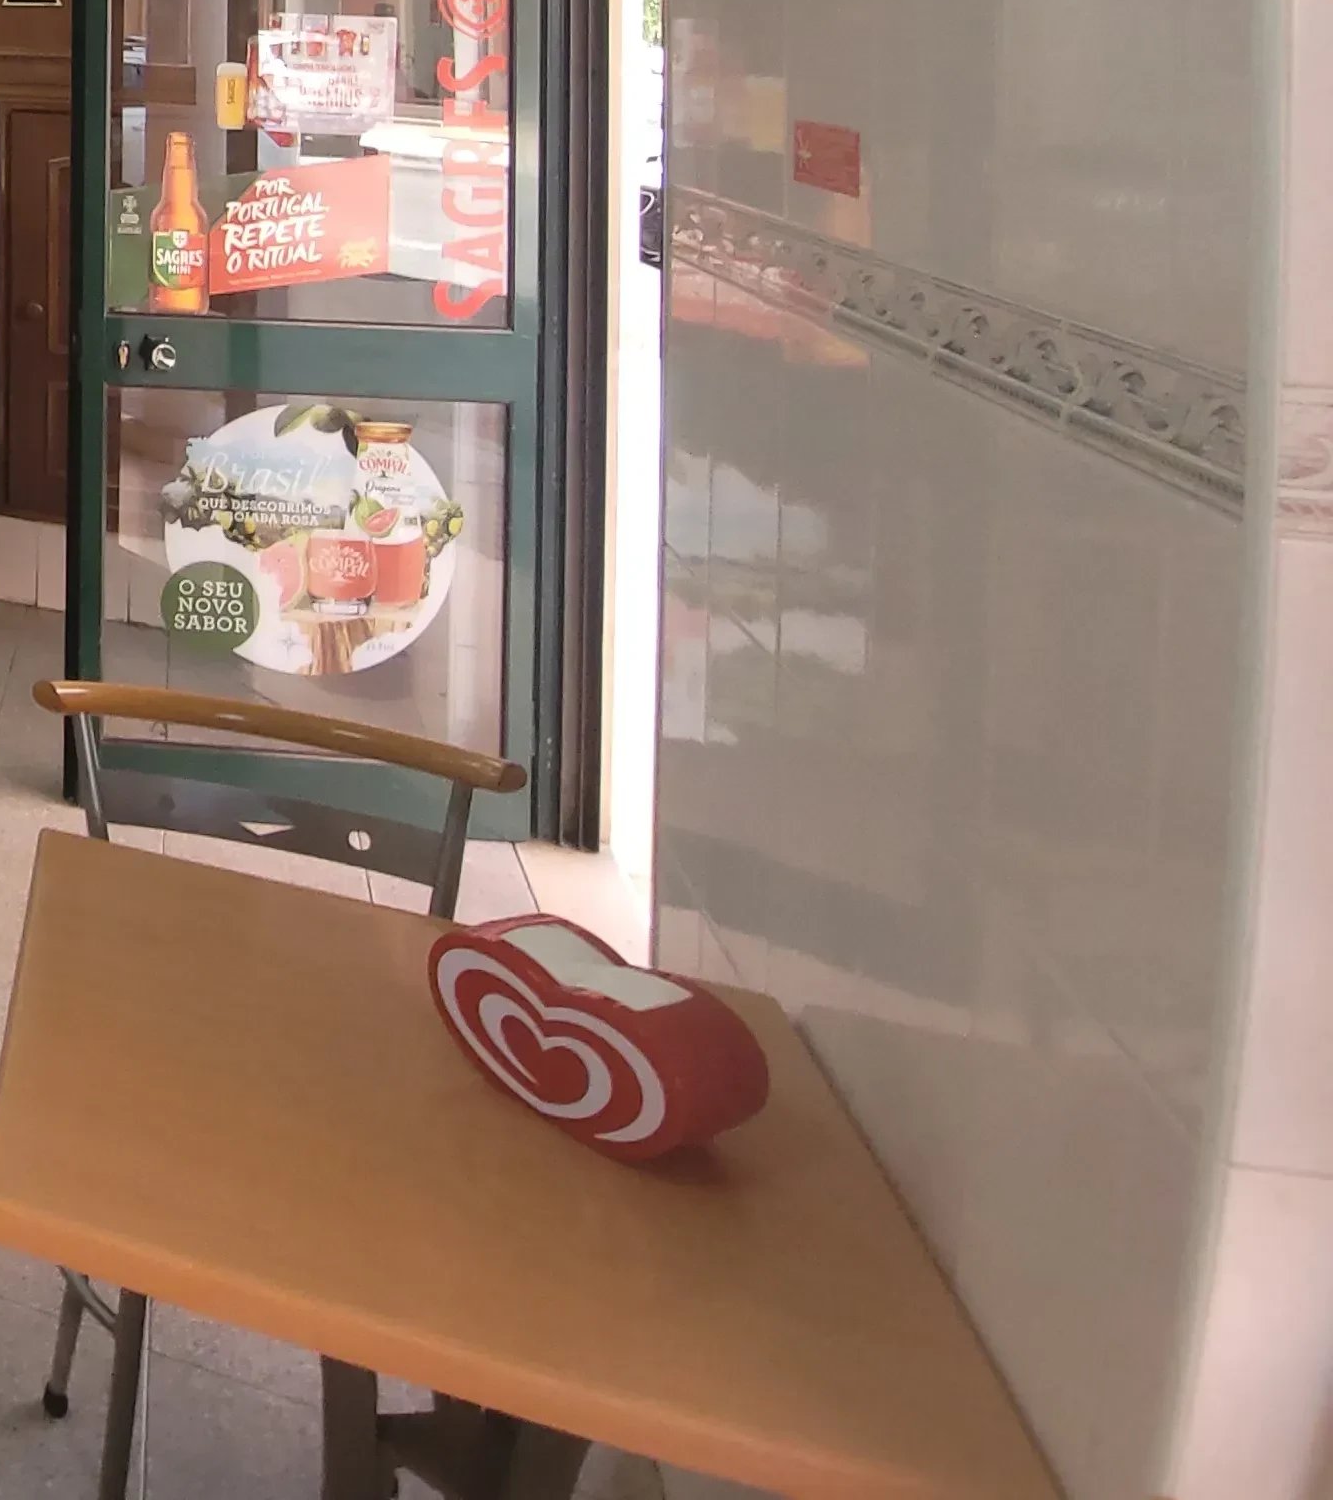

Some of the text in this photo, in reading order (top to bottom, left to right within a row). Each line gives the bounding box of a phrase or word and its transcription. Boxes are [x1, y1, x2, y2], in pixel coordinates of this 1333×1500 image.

[255, 177, 296, 198] POR
[433, 56, 506, 319] SAGRES
[225, 192, 329, 222] PORTUGAL
[221, 215, 326, 255] REPETE
[155, 247, 204, 267] SAGRES
[226, 251, 242, 273] O
[247, 241, 323, 271] RITUAL
[202, 452, 332, 494] Brasil
[199, 498, 331, 515] QUE DESCOBRIMOS
[281, 514, 319, 526] ROSA
[179, 580, 243, 598] O SEU
[179, 596, 243, 616] NOVO
[174, 614, 249, 634] SABOR
